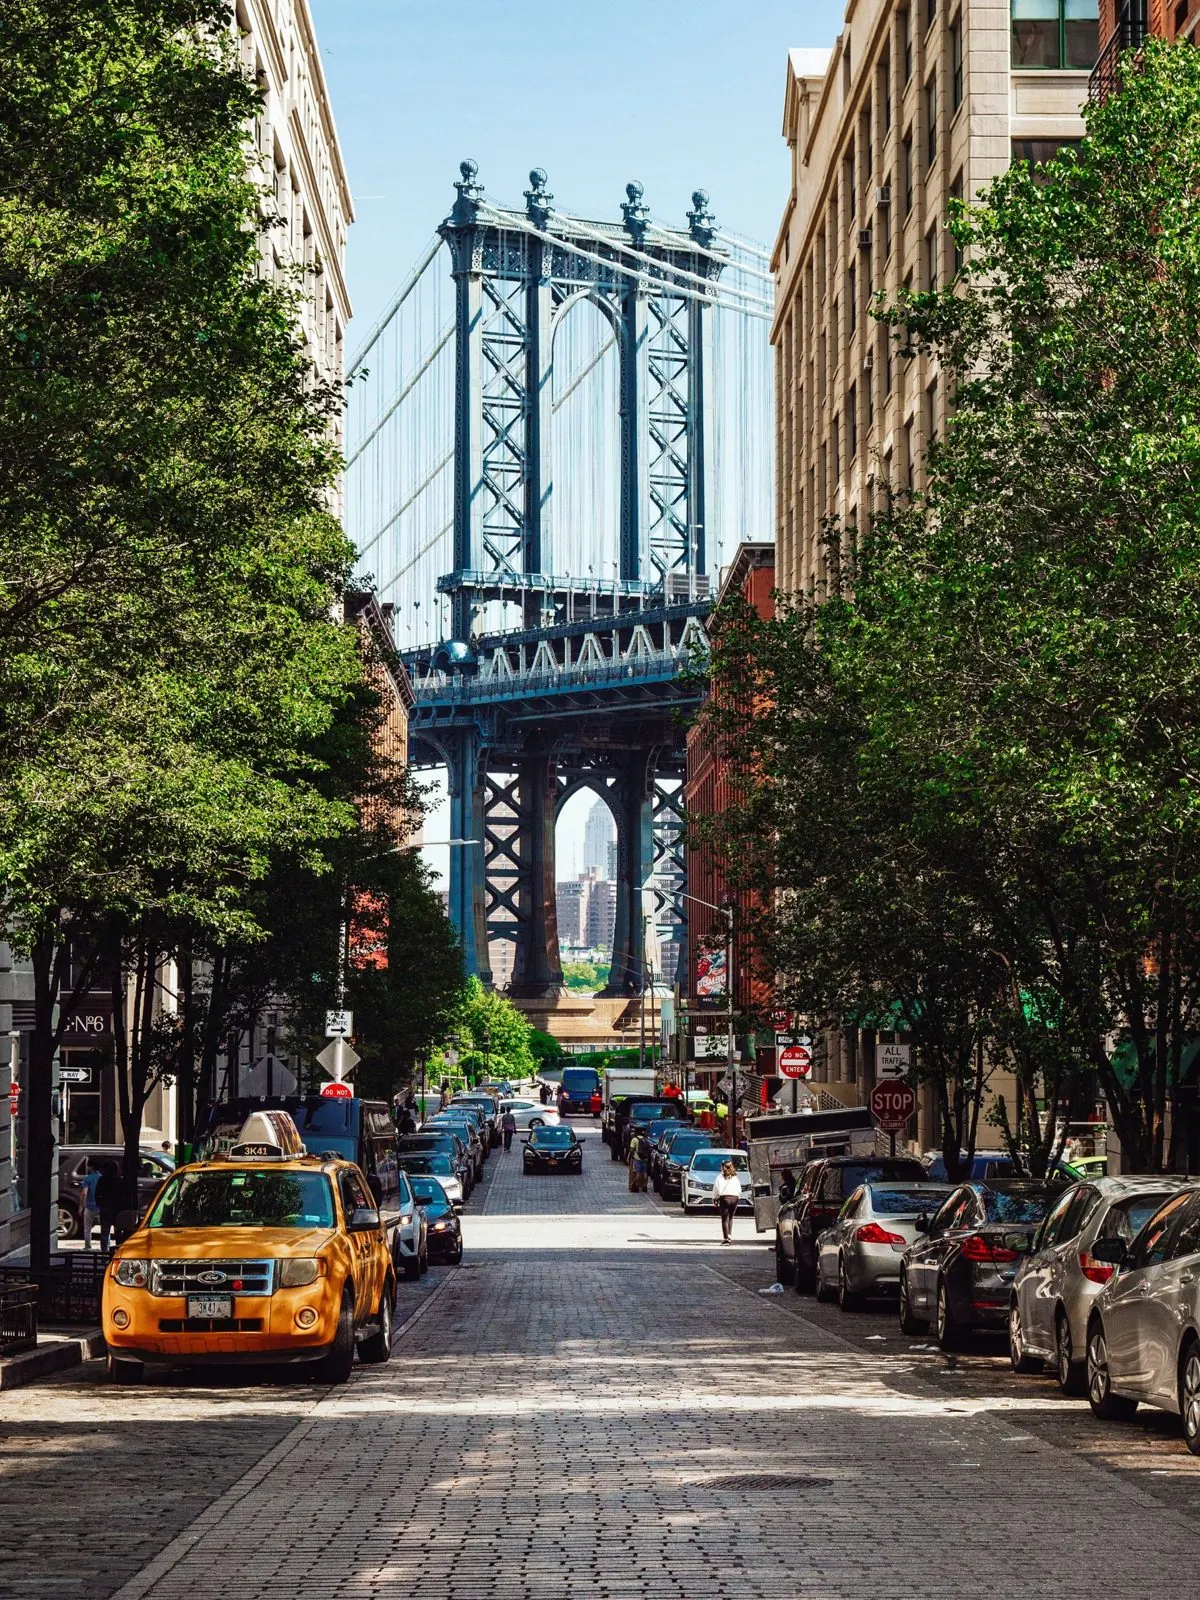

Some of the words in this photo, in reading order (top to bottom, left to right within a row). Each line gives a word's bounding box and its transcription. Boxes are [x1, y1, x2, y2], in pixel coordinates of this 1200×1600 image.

[885, 1047, 902, 1056] ALL
[874, 1093, 912, 1110] STOP
[244, 1147, 268, 1155] 3K41
